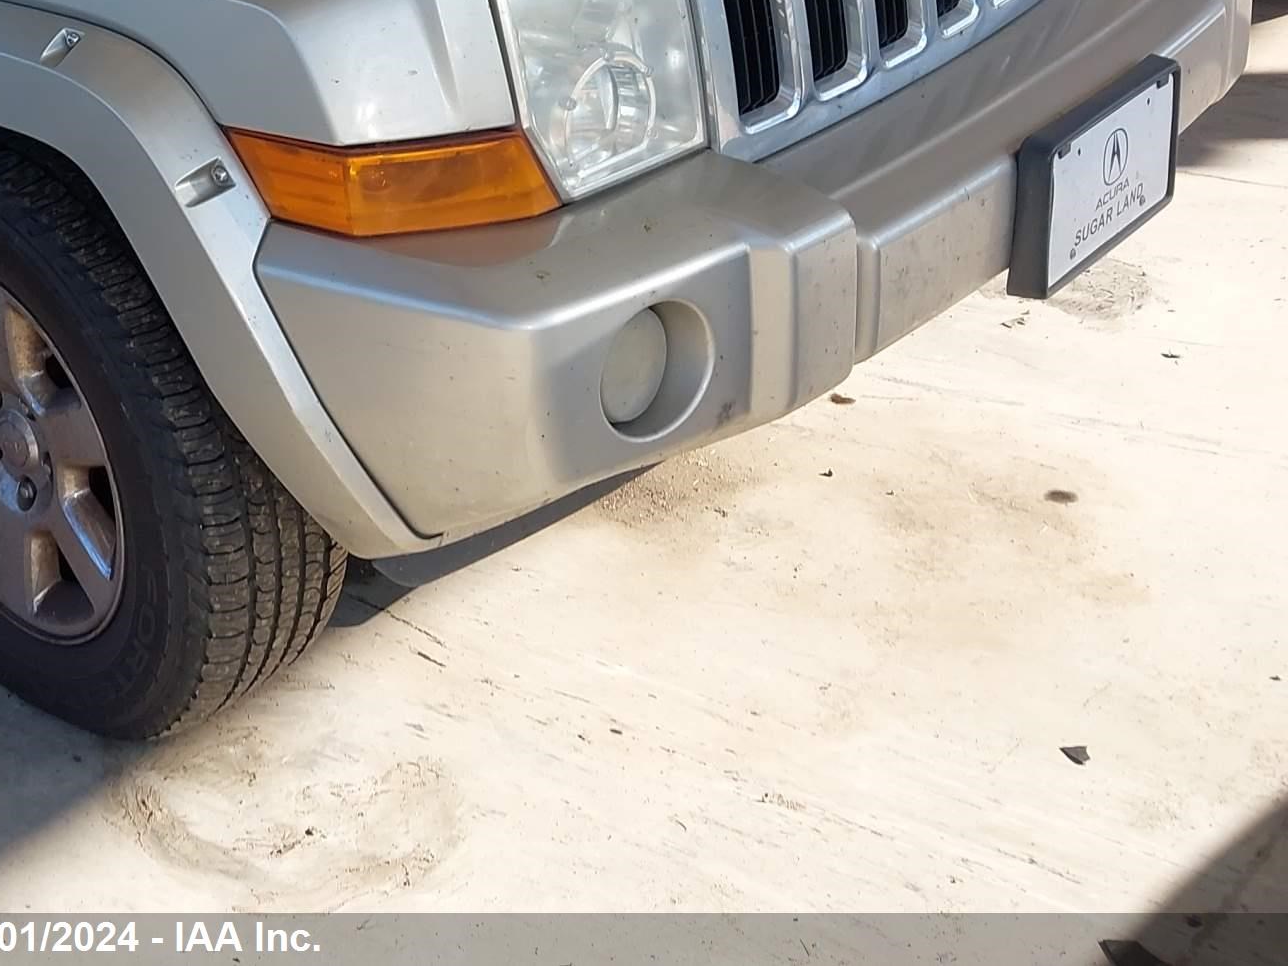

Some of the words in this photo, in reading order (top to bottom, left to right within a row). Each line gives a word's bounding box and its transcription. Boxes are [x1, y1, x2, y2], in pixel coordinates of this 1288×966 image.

[1074, 206, 1114, 247] SUGAR
[1116, 182, 1144, 217] LAND
[1095, 178, 1130, 211] ACURA
